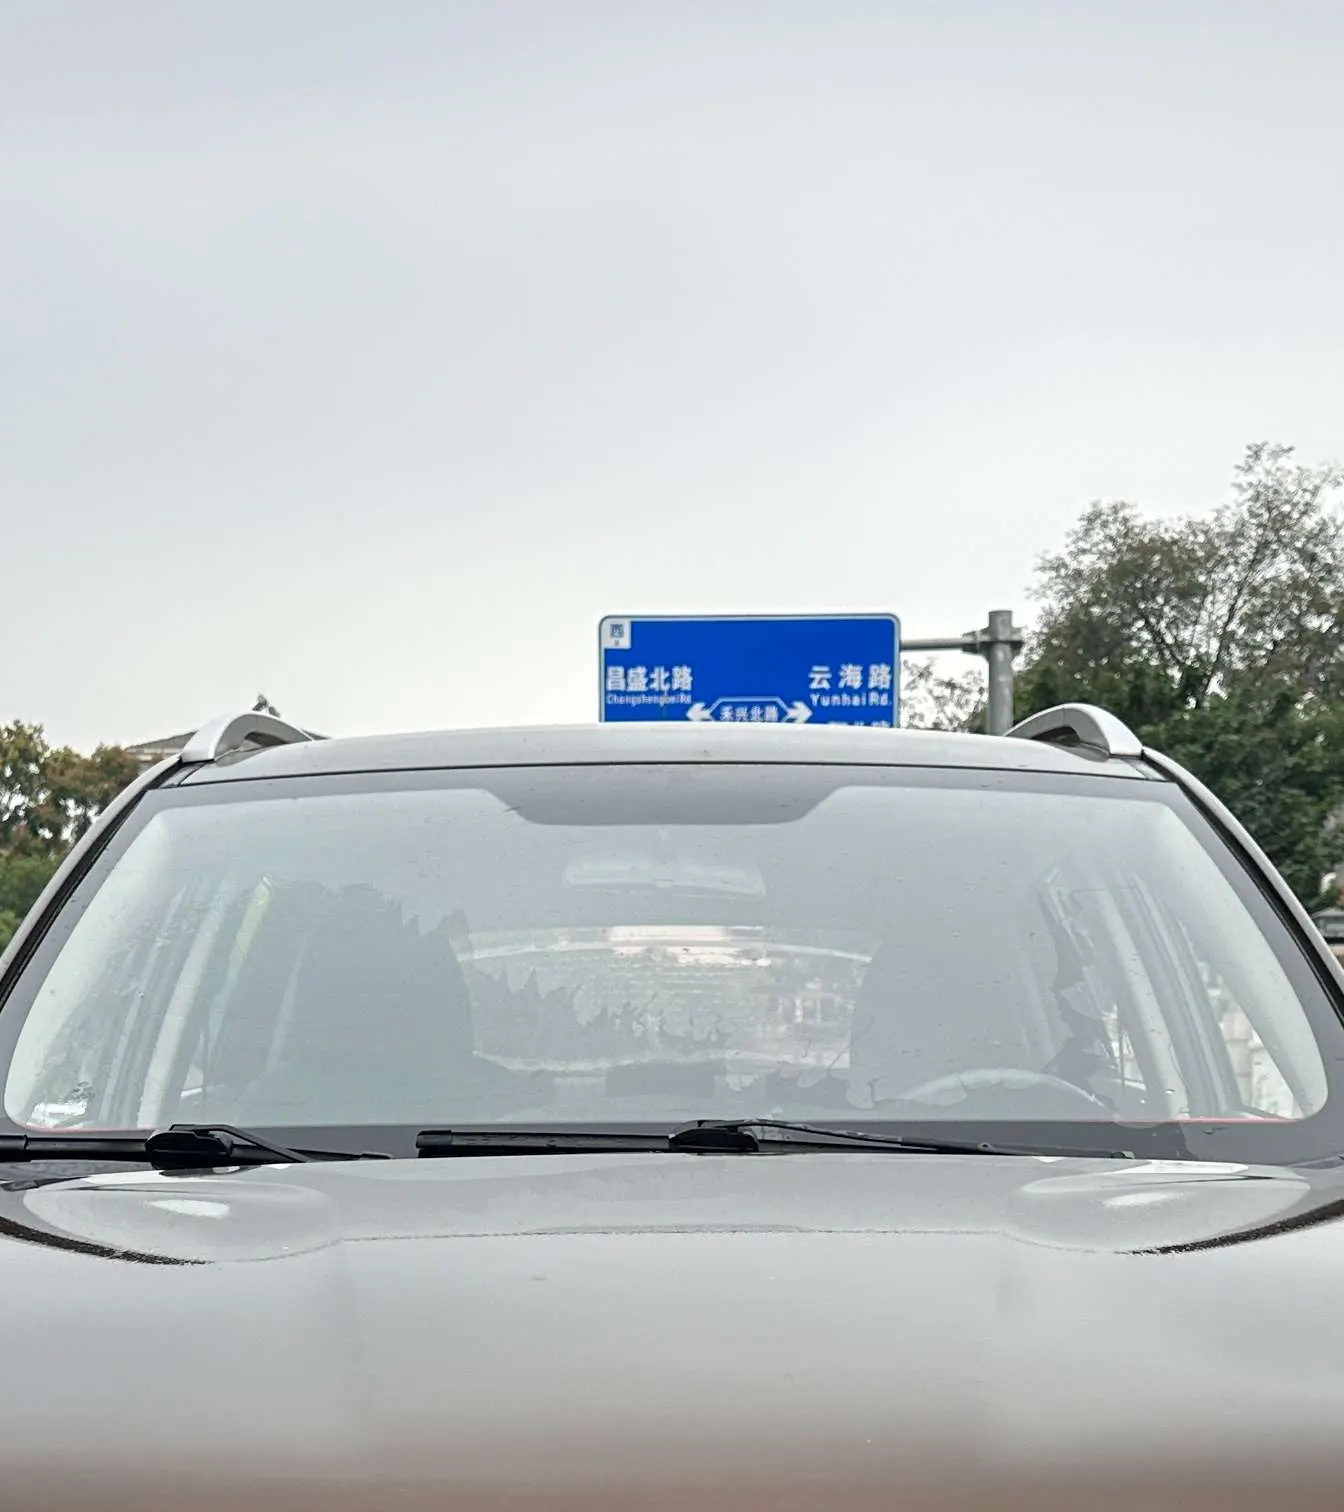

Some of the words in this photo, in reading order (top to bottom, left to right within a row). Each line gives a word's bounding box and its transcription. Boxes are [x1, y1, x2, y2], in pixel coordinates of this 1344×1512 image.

[606, 665, 693, 692] 昌盛北路
[808, 663, 892, 690] 云海路
[809, 692, 867, 707] Yunhai
